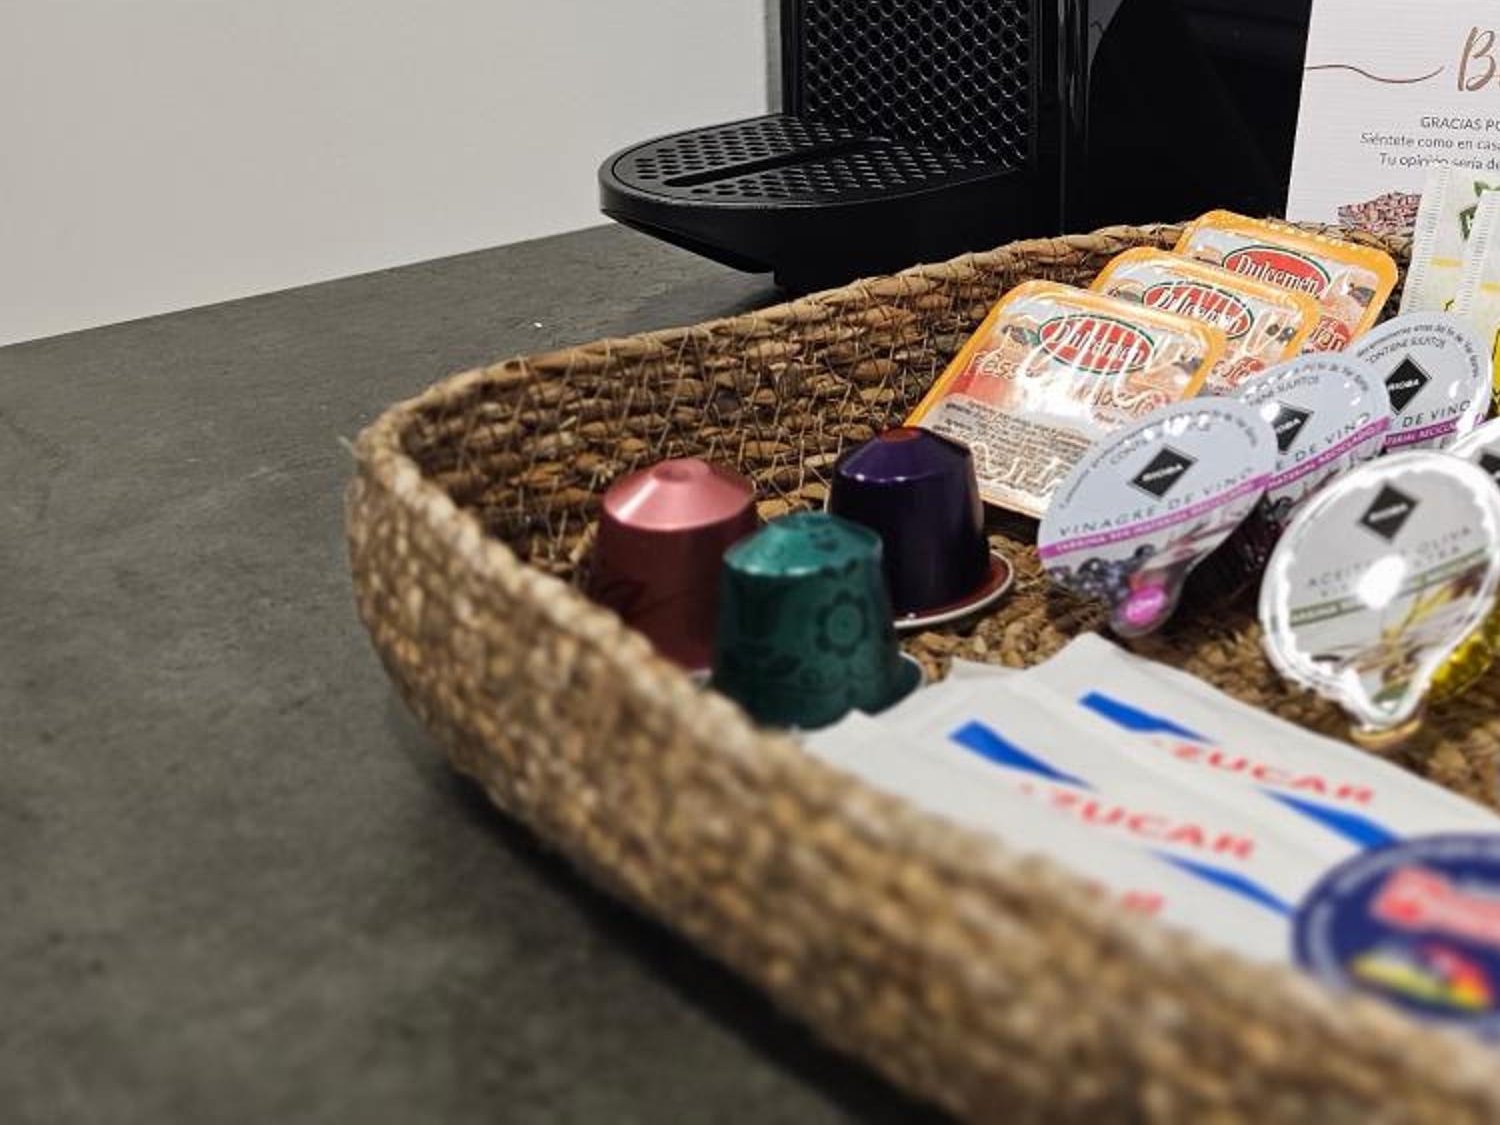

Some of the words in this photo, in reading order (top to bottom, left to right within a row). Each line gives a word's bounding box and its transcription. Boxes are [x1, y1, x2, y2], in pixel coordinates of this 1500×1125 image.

[1420, 116, 1482, 131] GRACIAS
[1360, 132, 1414, 148] Siéntete
[1418, 137, 1453, 149] como
[1458, 140, 1473, 150] en
[1379, 152, 1397, 165] Tu
[1402, 415, 1424, 428] DE
[1430, 399, 1471, 421] VINO
[1150, 737, 1375, 806] ZUCAR
[1018, 779, 1256, 860] ZUCAR
